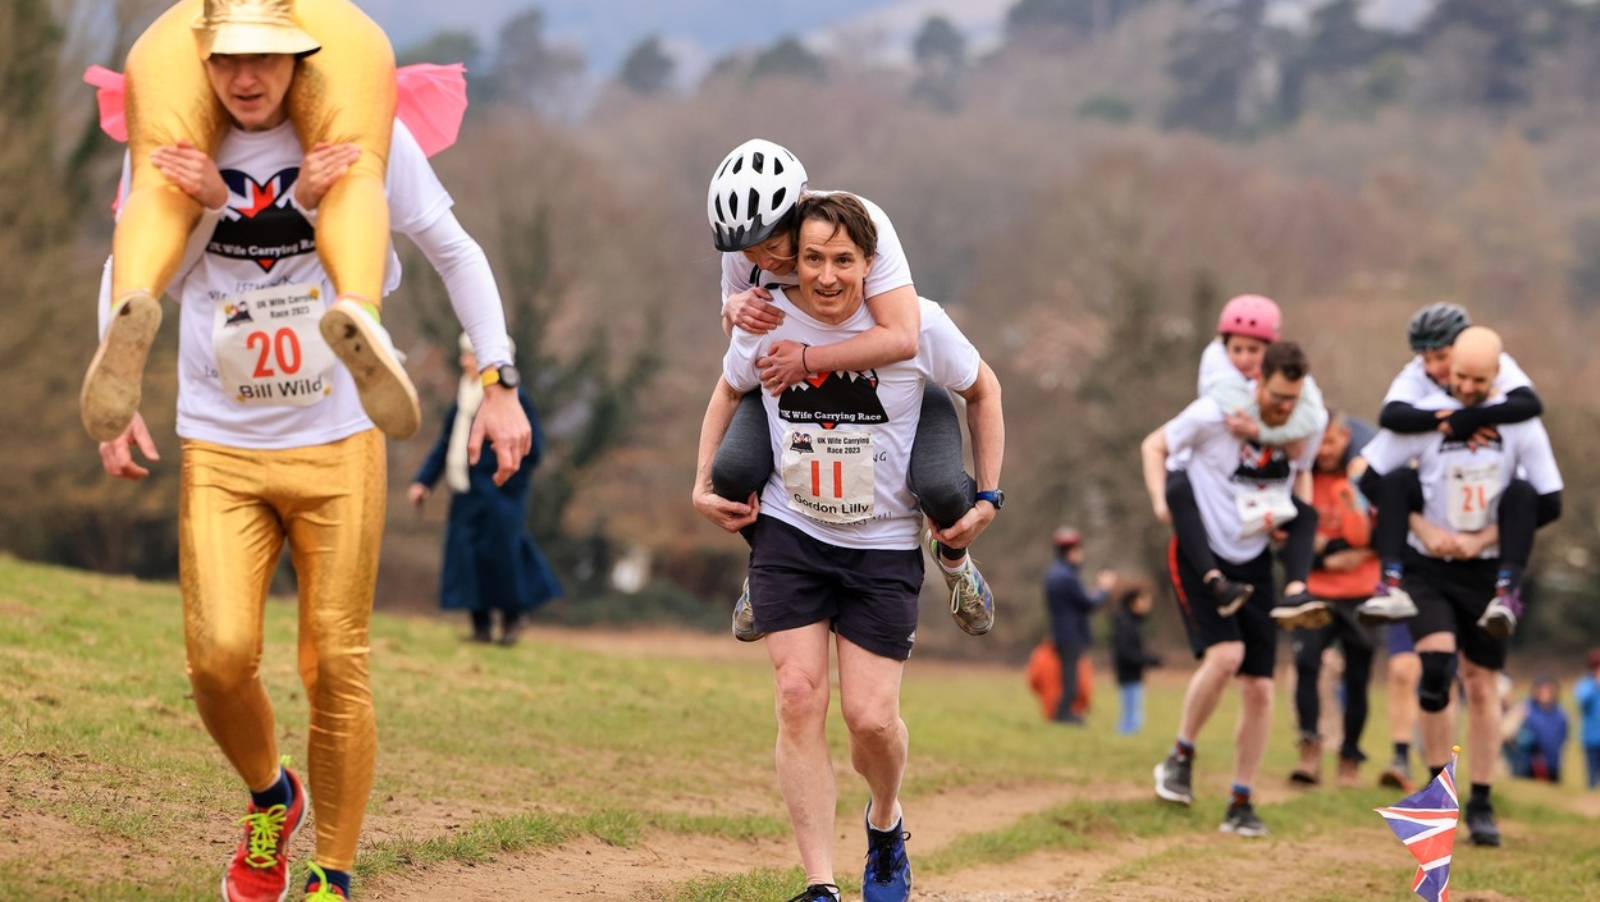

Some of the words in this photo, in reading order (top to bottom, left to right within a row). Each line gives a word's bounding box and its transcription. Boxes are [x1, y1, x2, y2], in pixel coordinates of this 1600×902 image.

[248, 244, 299, 258] Carrying
[300, 239, 315, 250] Ra
[288, 293, 319, 304] Carryi
[246, 326, 303, 378] 20
[239, 383, 273, 399] Bill
[278, 374, 323, 397] Wild
[792, 410, 813, 419] Wife
[814, 411, 856, 421] Carrying
[858, 412, 882, 421] Race
[817, 437, 827, 445] UK
[828, 437, 842, 445] Wife
[843, 437, 870, 446] Carrying
[826, 446, 843, 454] Race
[844, 446, 861, 454] 2023
[811, 460, 843, 498] 11
[793, 493, 838, 514] Gordon
[841, 503, 869, 514] Lilly
[1462, 485, 1487, 512] 21
